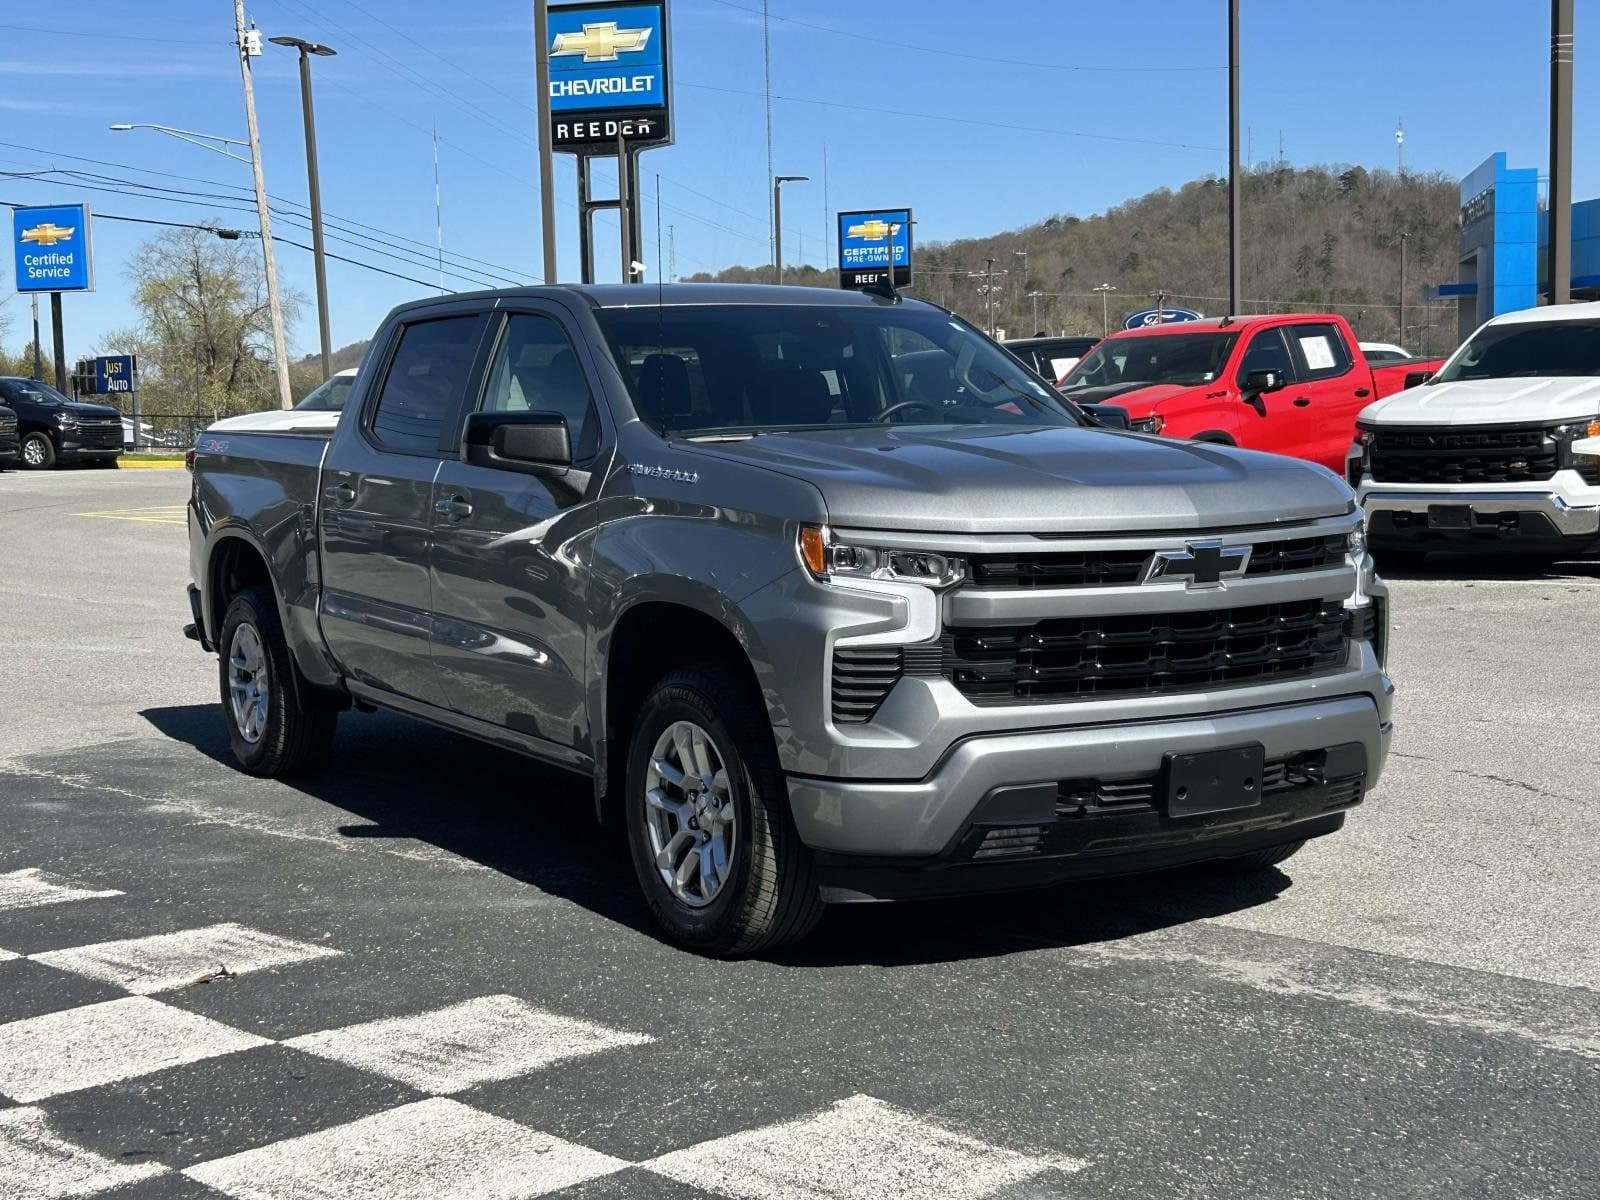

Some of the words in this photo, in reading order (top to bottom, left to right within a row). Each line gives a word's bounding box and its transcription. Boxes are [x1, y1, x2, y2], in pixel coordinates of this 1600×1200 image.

[550, 75, 655, 97] CHEVROLET
[557, 118, 650, 138] REEDER
[24, 252, 73, 265] Certified
[847, 254, 902, 263] PRE-OWND
[28, 266, 71, 278] Service
[103, 360, 123, 378] JUST
[108, 376, 128, 391] AUTO
